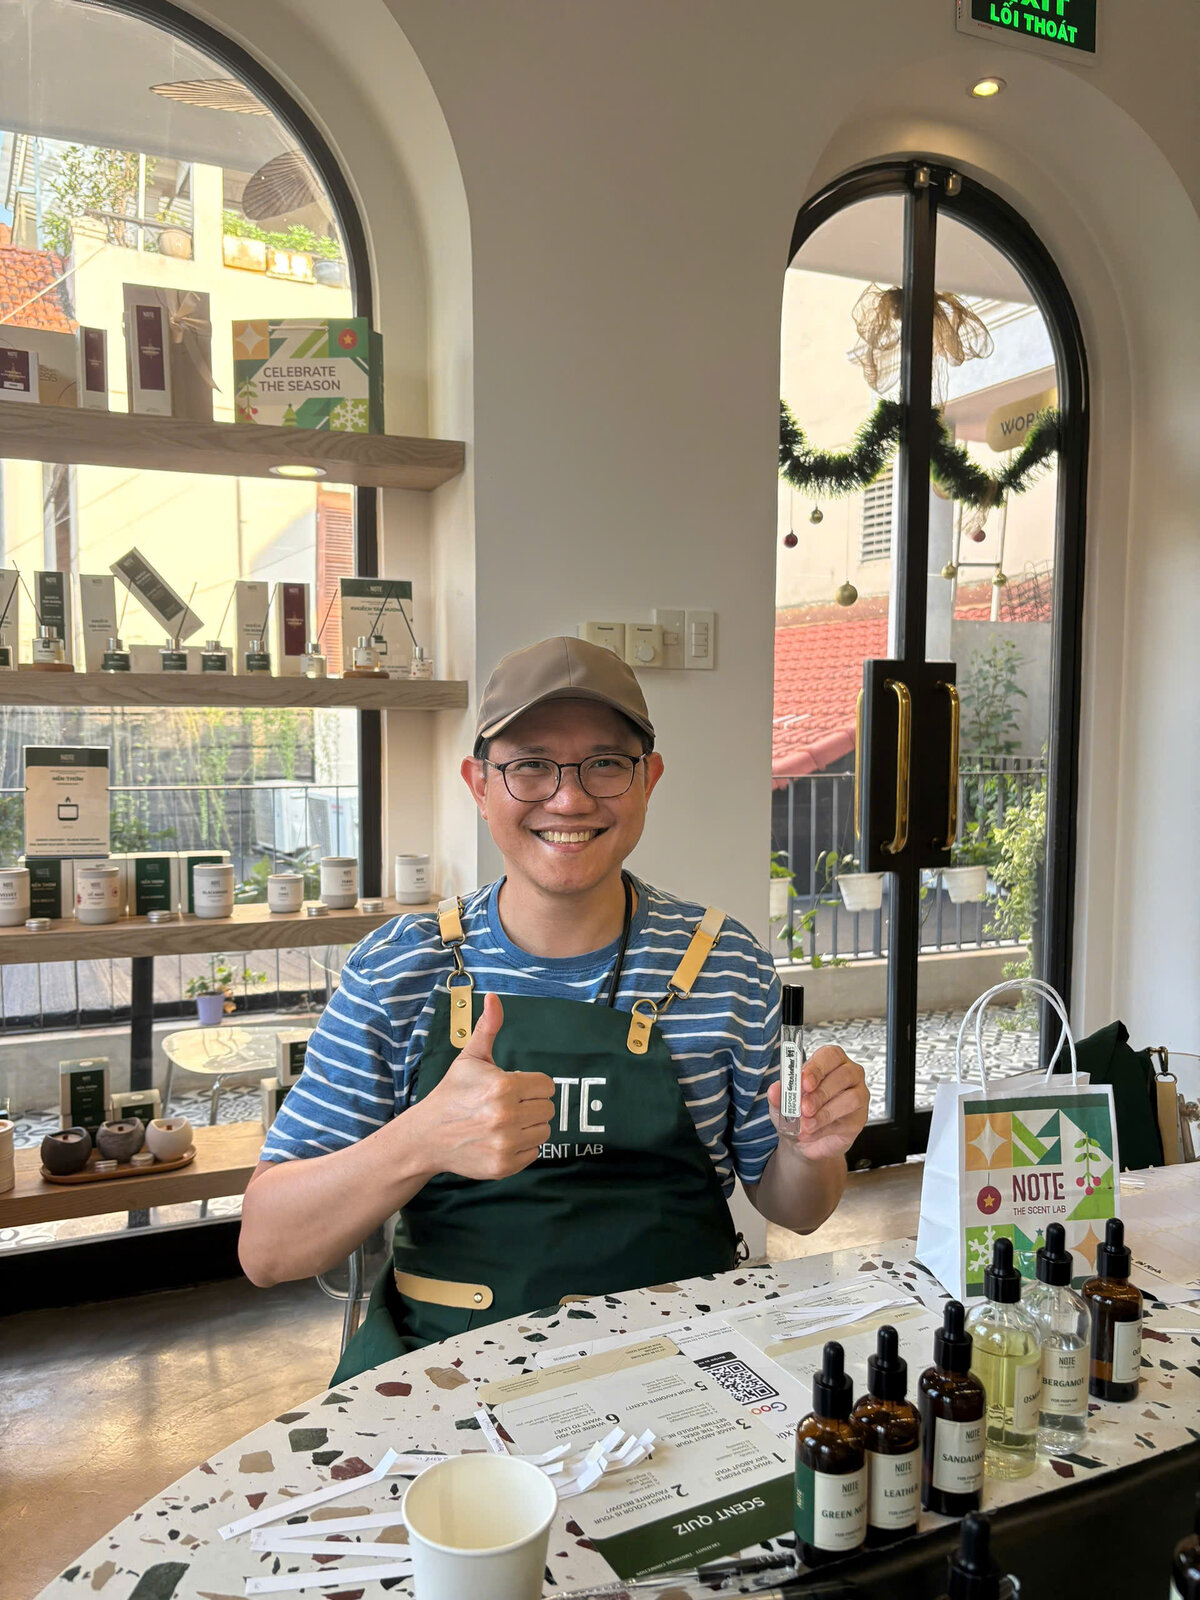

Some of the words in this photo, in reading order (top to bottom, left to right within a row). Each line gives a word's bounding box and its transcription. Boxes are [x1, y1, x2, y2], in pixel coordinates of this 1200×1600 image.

[1010, 0, 1070, 16] XIT
[990, 2, 1019, 28] LỐI
[1024, 13, 1078, 43] THOÁT
[262, 365, 336, 379] CELEBRATE
[258, 379, 285, 392] THE
[287, 379, 341, 391] SEASON
[552, 1077, 607, 1133] TE
[537, 1143, 571, 1159] CENT
[575, 1143, 604, 1157] LAB
[1012, 1172, 1066, 1203] NOTE
[1013, 1207, 1026, 1216] THE
[1027, 1205, 1051, 1215] SCENT
[1052, 1204, 1067, 1214] LAB
[1059, 1356, 1076, 1366] NOTE
[691, 1380, 709, 1391] 5
[1042, 1377, 1084, 1387] BERGAMOT
[647, 1392, 678, 1403] FAVORITE
[623, 1400, 649, 1410] SCENT?
[750, 1402, 787, 1415] Goo
[580, 1417, 602, 1425] WANT
[602, 1412, 622, 1425] 6
[699, 1417, 727, 1427] SETTING
[733, 1417, 752, 1430] 3
[551, 1426, 571, 1434] LIVE?
[580, 1421, 606, 1431] WHERE
[675, 1425, 701, 1435] WOULD
[714, 1425, 736, 1434] IMAGE
[680, 1431, 701, 1439] IDEAL
[692, 1432, 716, 1441] ABOUT
[966, 1427, 981, 1440] NOTE
[673, 1439, 694, 1447] YOUR
[770, 1451, 787, 1463] 1
[730, 1459, 755, 1470] ABOUT
[751, 1459, 773, 1469] WHAT
[895, 1460, 912, 1473] NOTE
[712, 1467, 731, 1476] YOU?
[714, 1470, 741, 1481] PEOPLE
[669, 1483, 690, 1498] 2
[842, 1480, 859, 1493] NOTE
[633, 1488, 669, 1503] FAVORITE
[646, 1493, 673, 1504] WHICH
[602, 1499, 635, 1513] BELOW?
[621, 1502, 647, 1513] COLOR
[711, 1496, 766, 1520] SCENT
[592, 1513, 615, 1524] YOUR
[821, 1508, 852, 1519] GREEN
[669, 1512, 715, 1535] QUIZ
